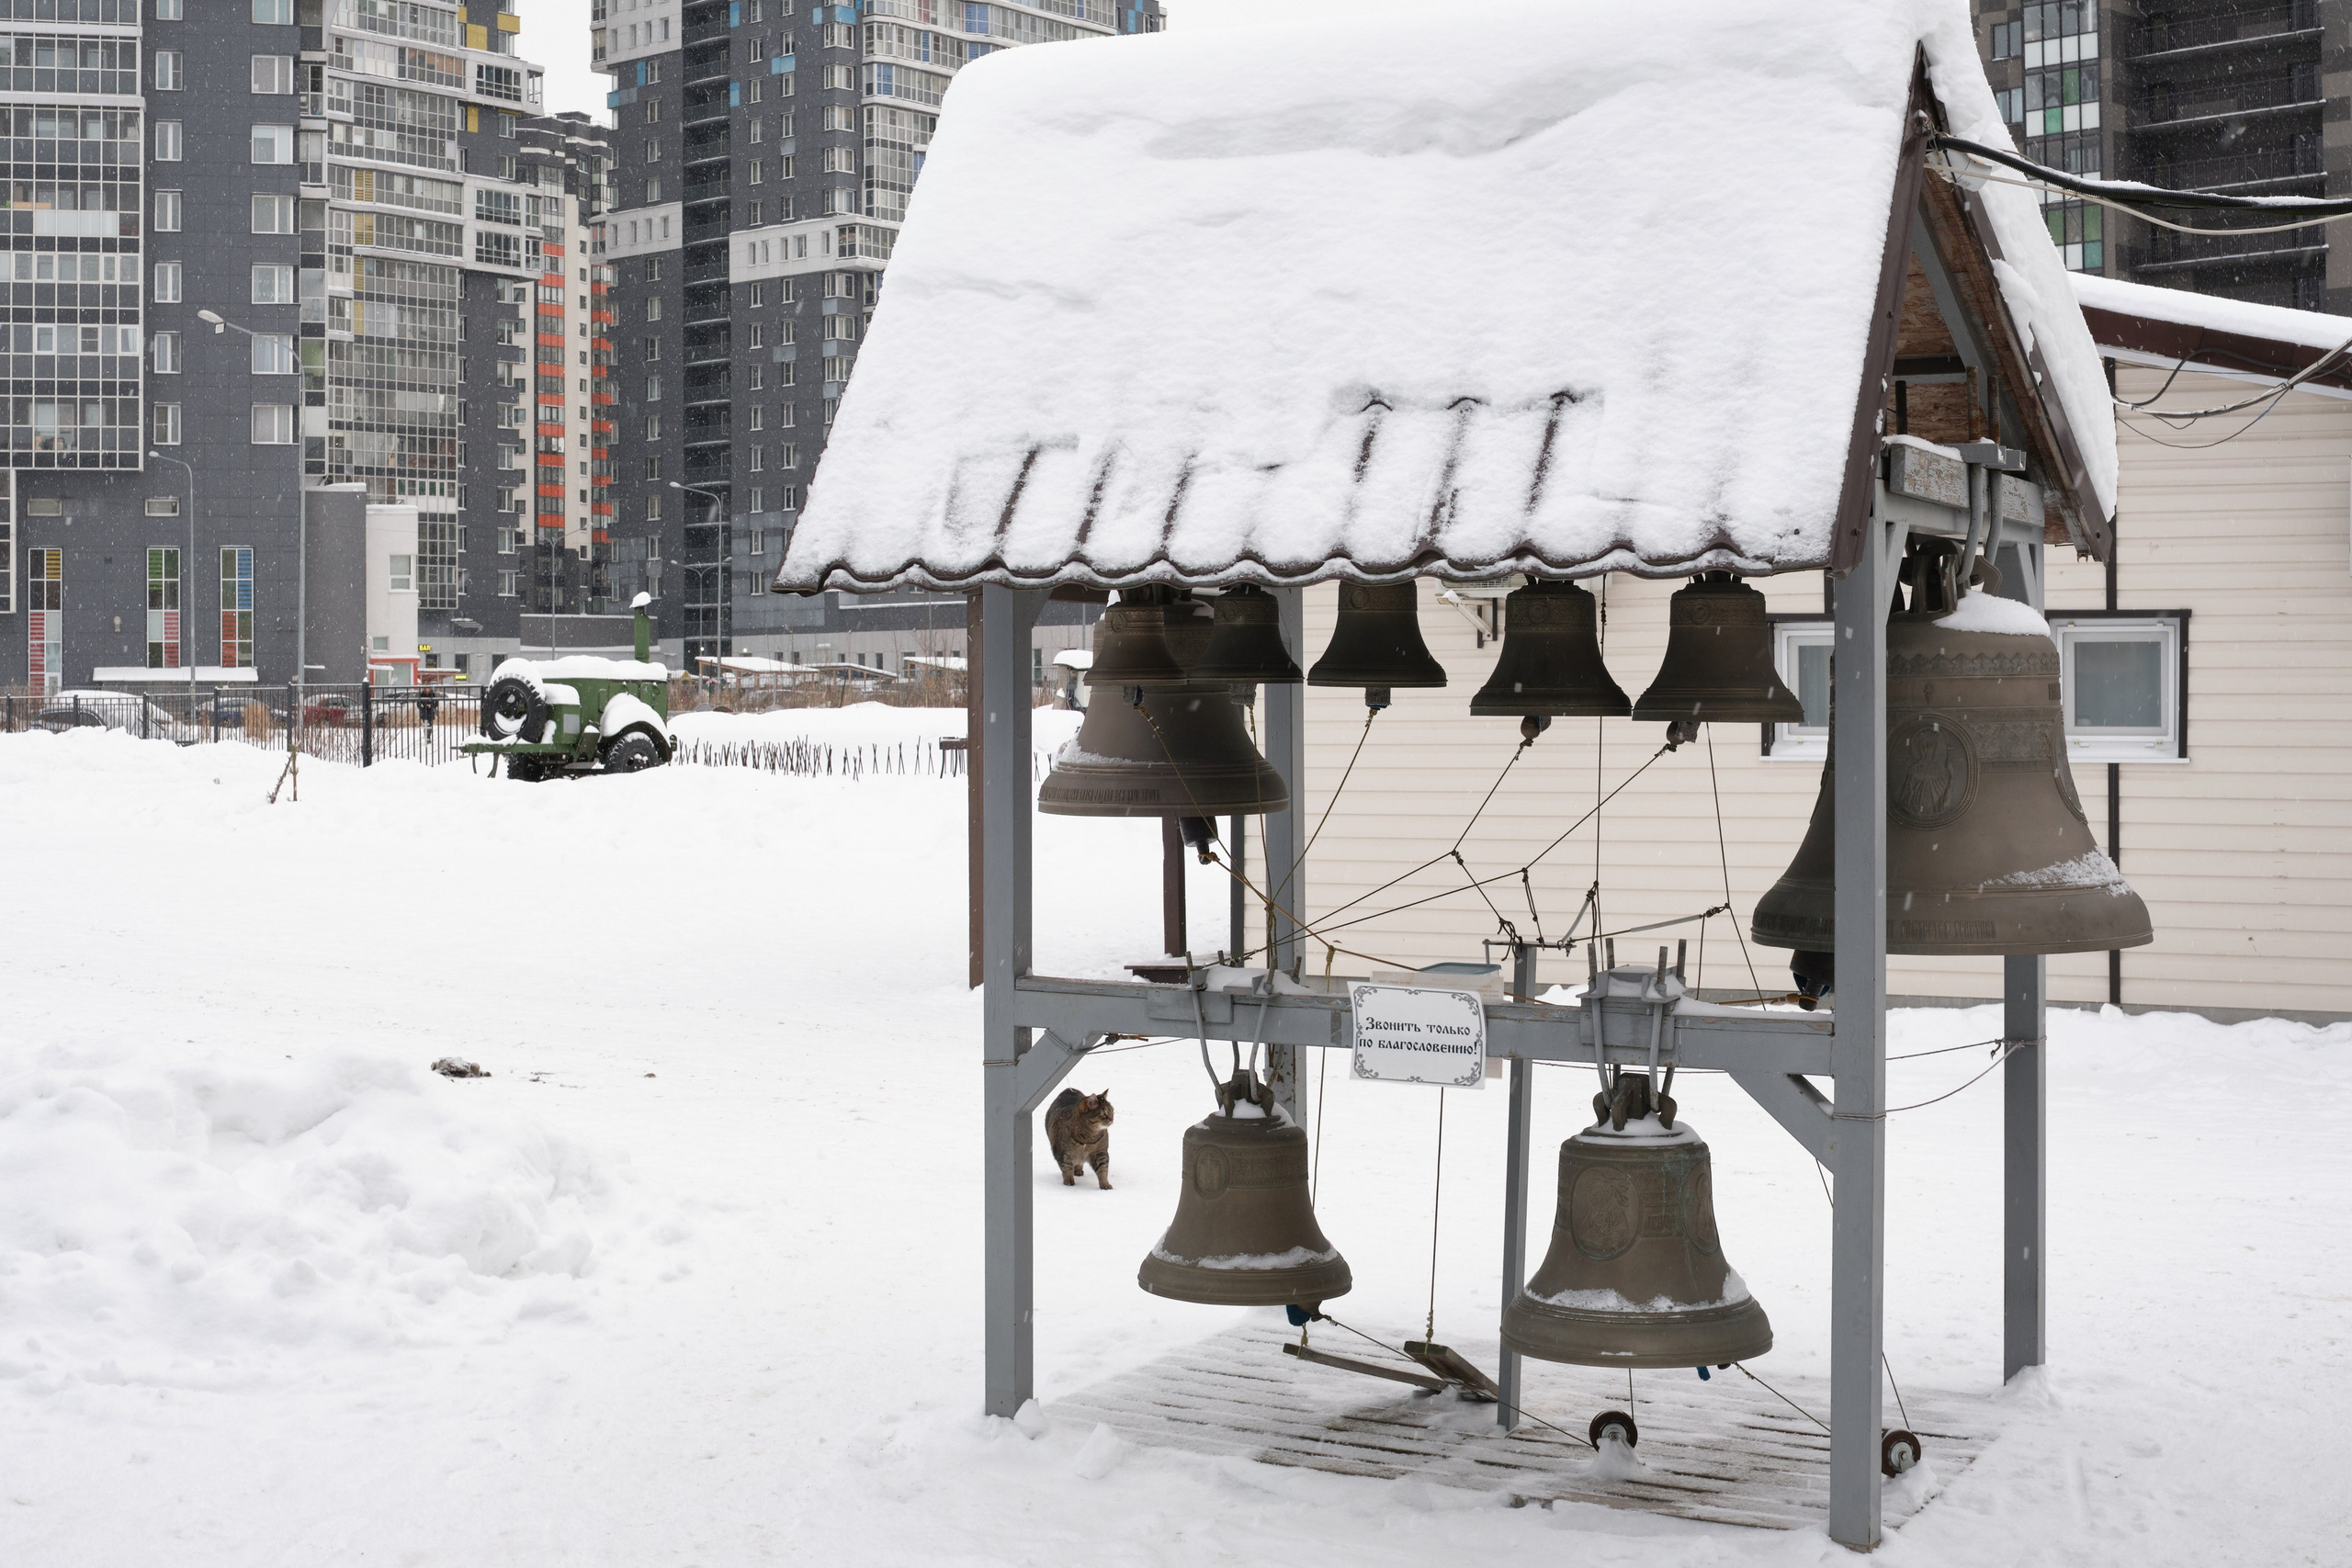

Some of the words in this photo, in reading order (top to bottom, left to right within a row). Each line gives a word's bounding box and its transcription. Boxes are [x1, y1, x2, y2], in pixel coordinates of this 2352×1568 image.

[1365, 1016, 1421, 1032] Звонить
[1426, 1023, 1471, 1036] только
[1359, 1038, 1373, 1048] по
[1378, 1038, 1477, 1055] благословению!
